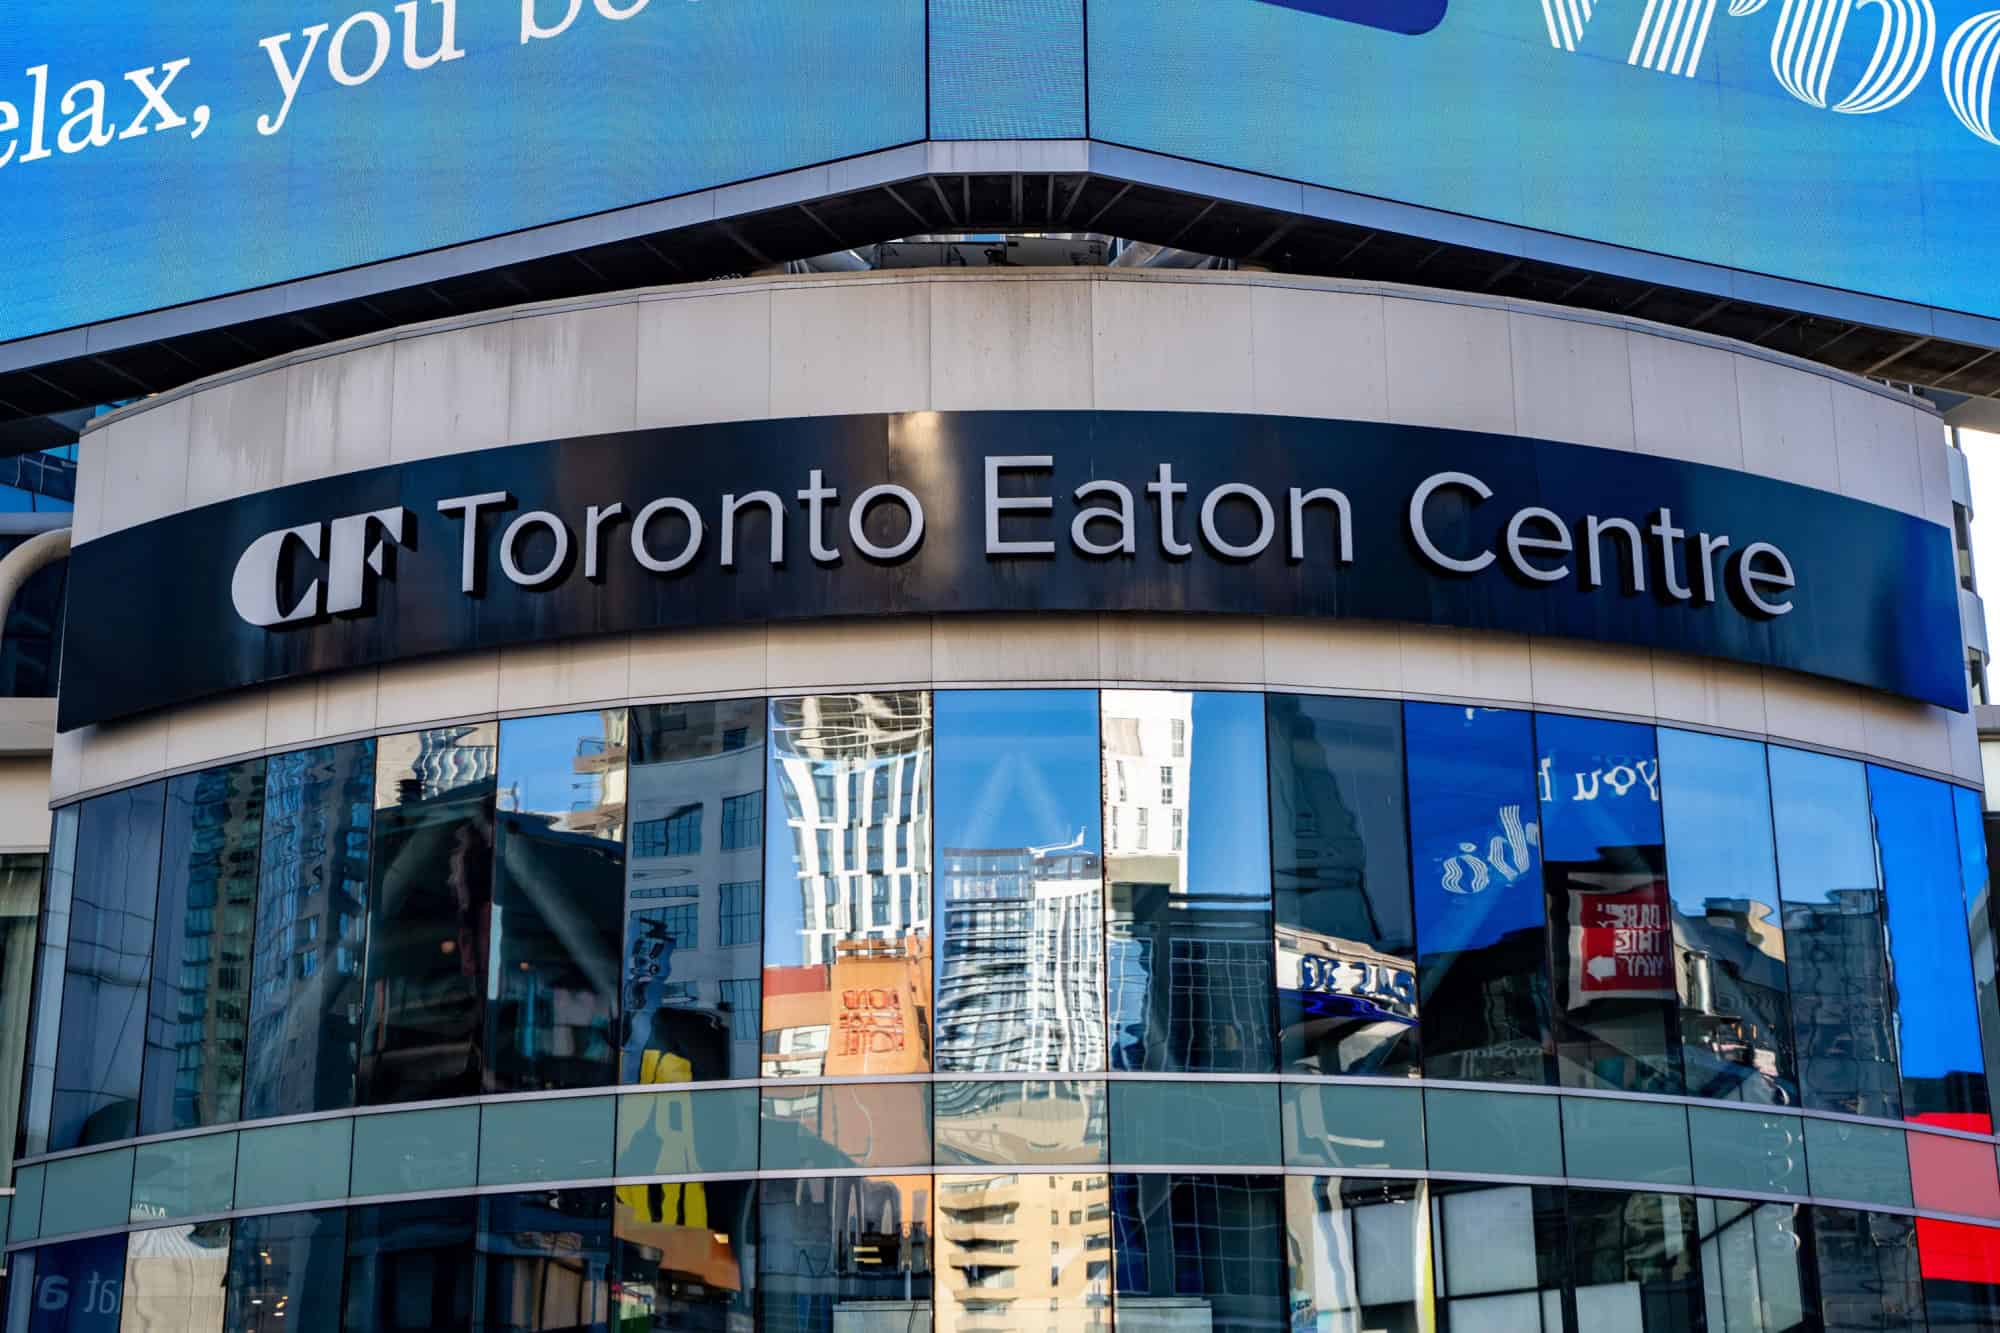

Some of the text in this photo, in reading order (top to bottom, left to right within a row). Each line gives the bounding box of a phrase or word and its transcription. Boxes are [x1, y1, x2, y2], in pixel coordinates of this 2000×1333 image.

[256, 0, 466, 137] you
[231, 455, 1796, 626] CF Toronto Eaton Centre
